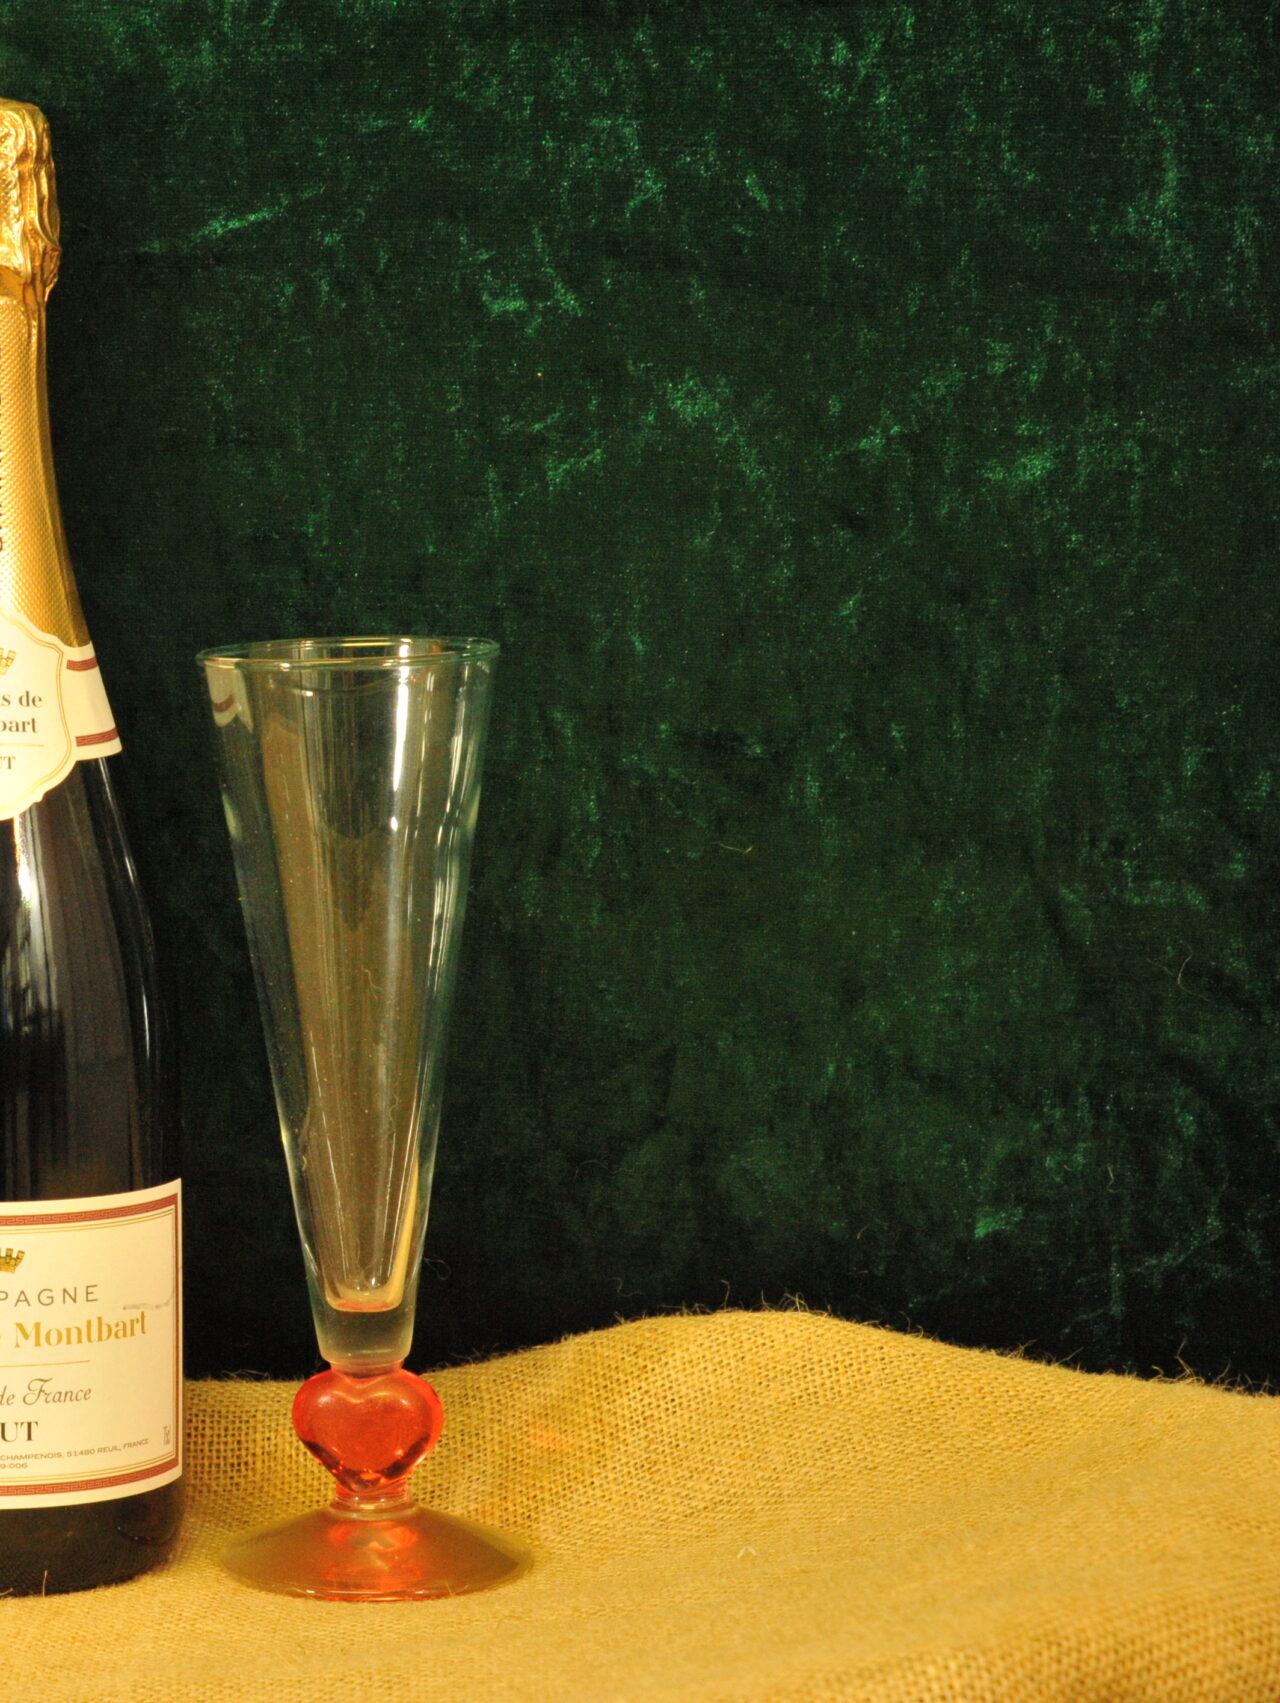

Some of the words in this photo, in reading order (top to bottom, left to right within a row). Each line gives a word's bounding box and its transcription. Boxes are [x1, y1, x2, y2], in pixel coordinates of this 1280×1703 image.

[18, 690, 42, 708] de
[14, 1311, 147, 1348] Montbart
[22, 1377, 92, 1406] France
[66, 1447, 96, 1457] 51480
[123, 1438, 149, 1449] FRANCE
